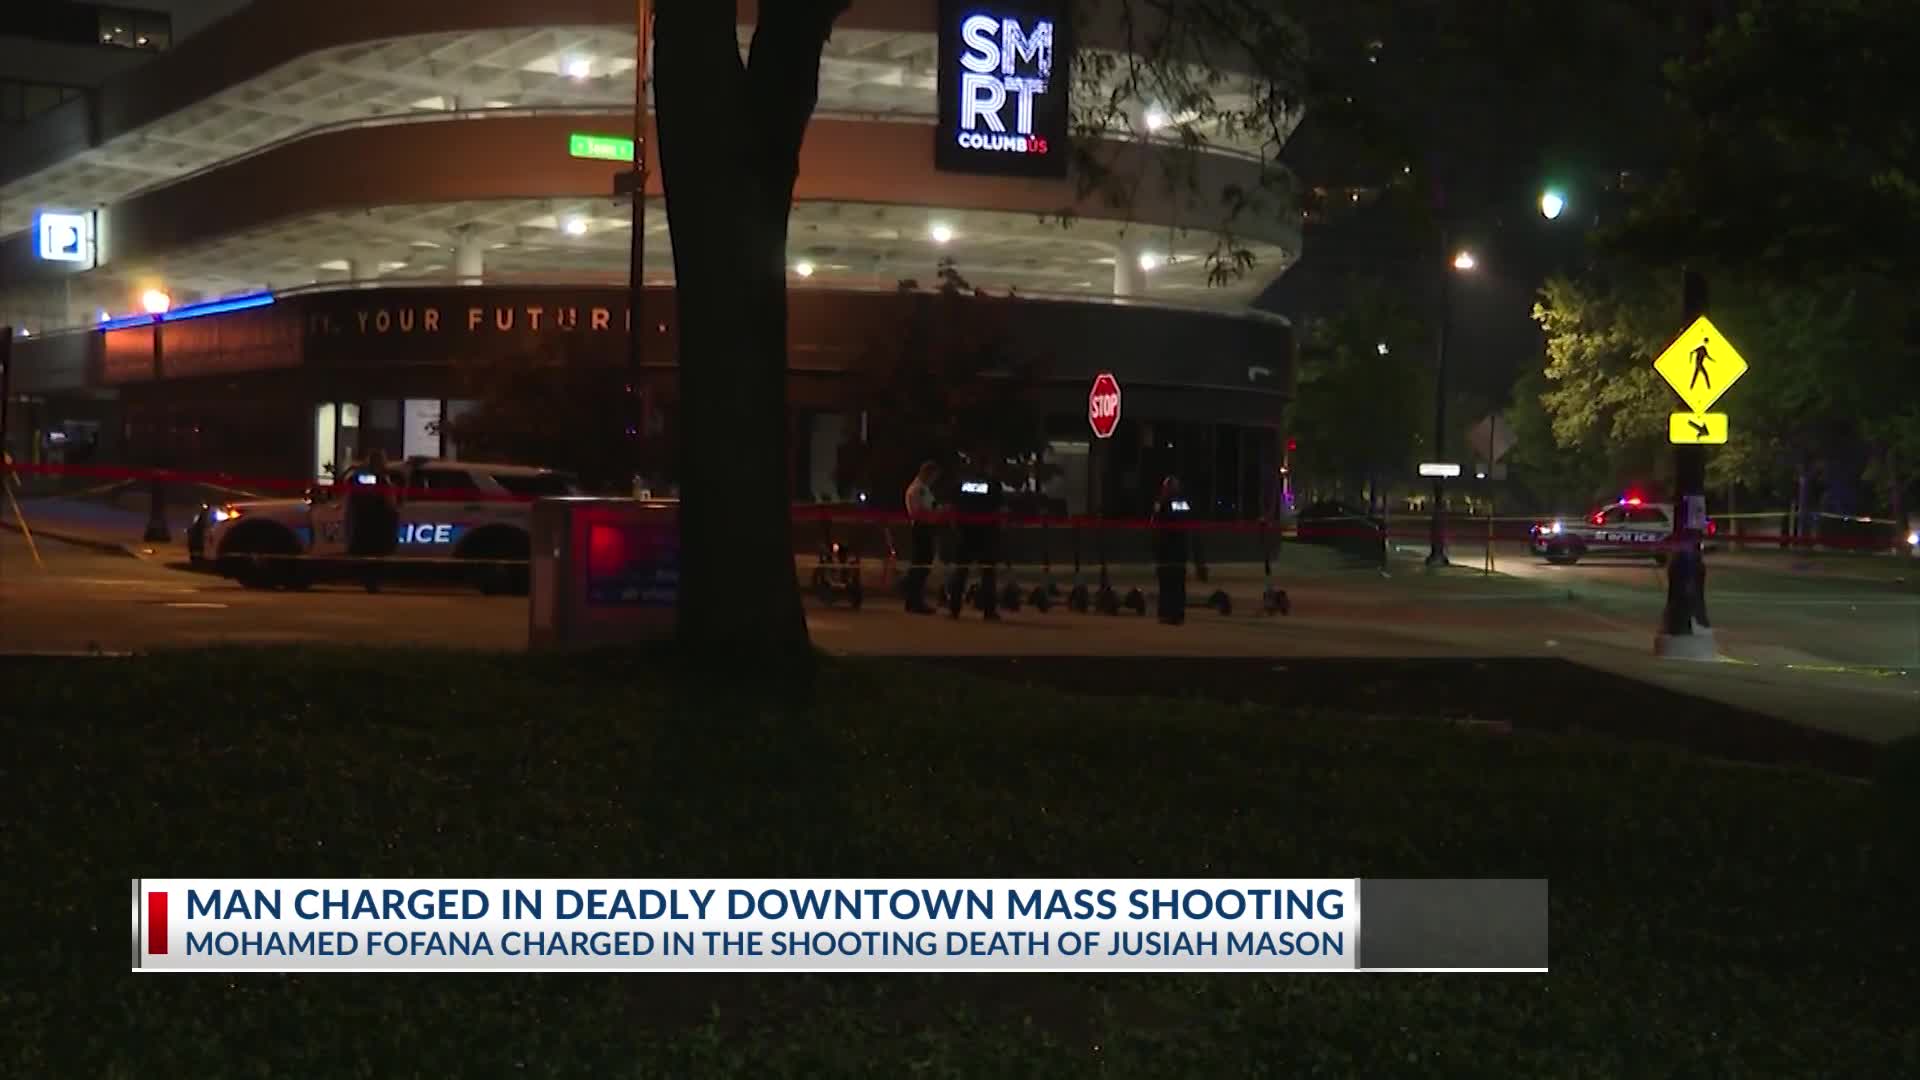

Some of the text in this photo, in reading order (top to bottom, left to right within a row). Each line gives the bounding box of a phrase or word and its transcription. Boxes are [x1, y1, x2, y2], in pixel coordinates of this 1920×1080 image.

[960, 15, 1053, 76] SM
[961, 73, 1048, 134] RT
[958, 132, 1048, 153] COLUMBUS
[357, 307, 440, 333] YOUR
[1092, 394, 1118, 418] STOP
